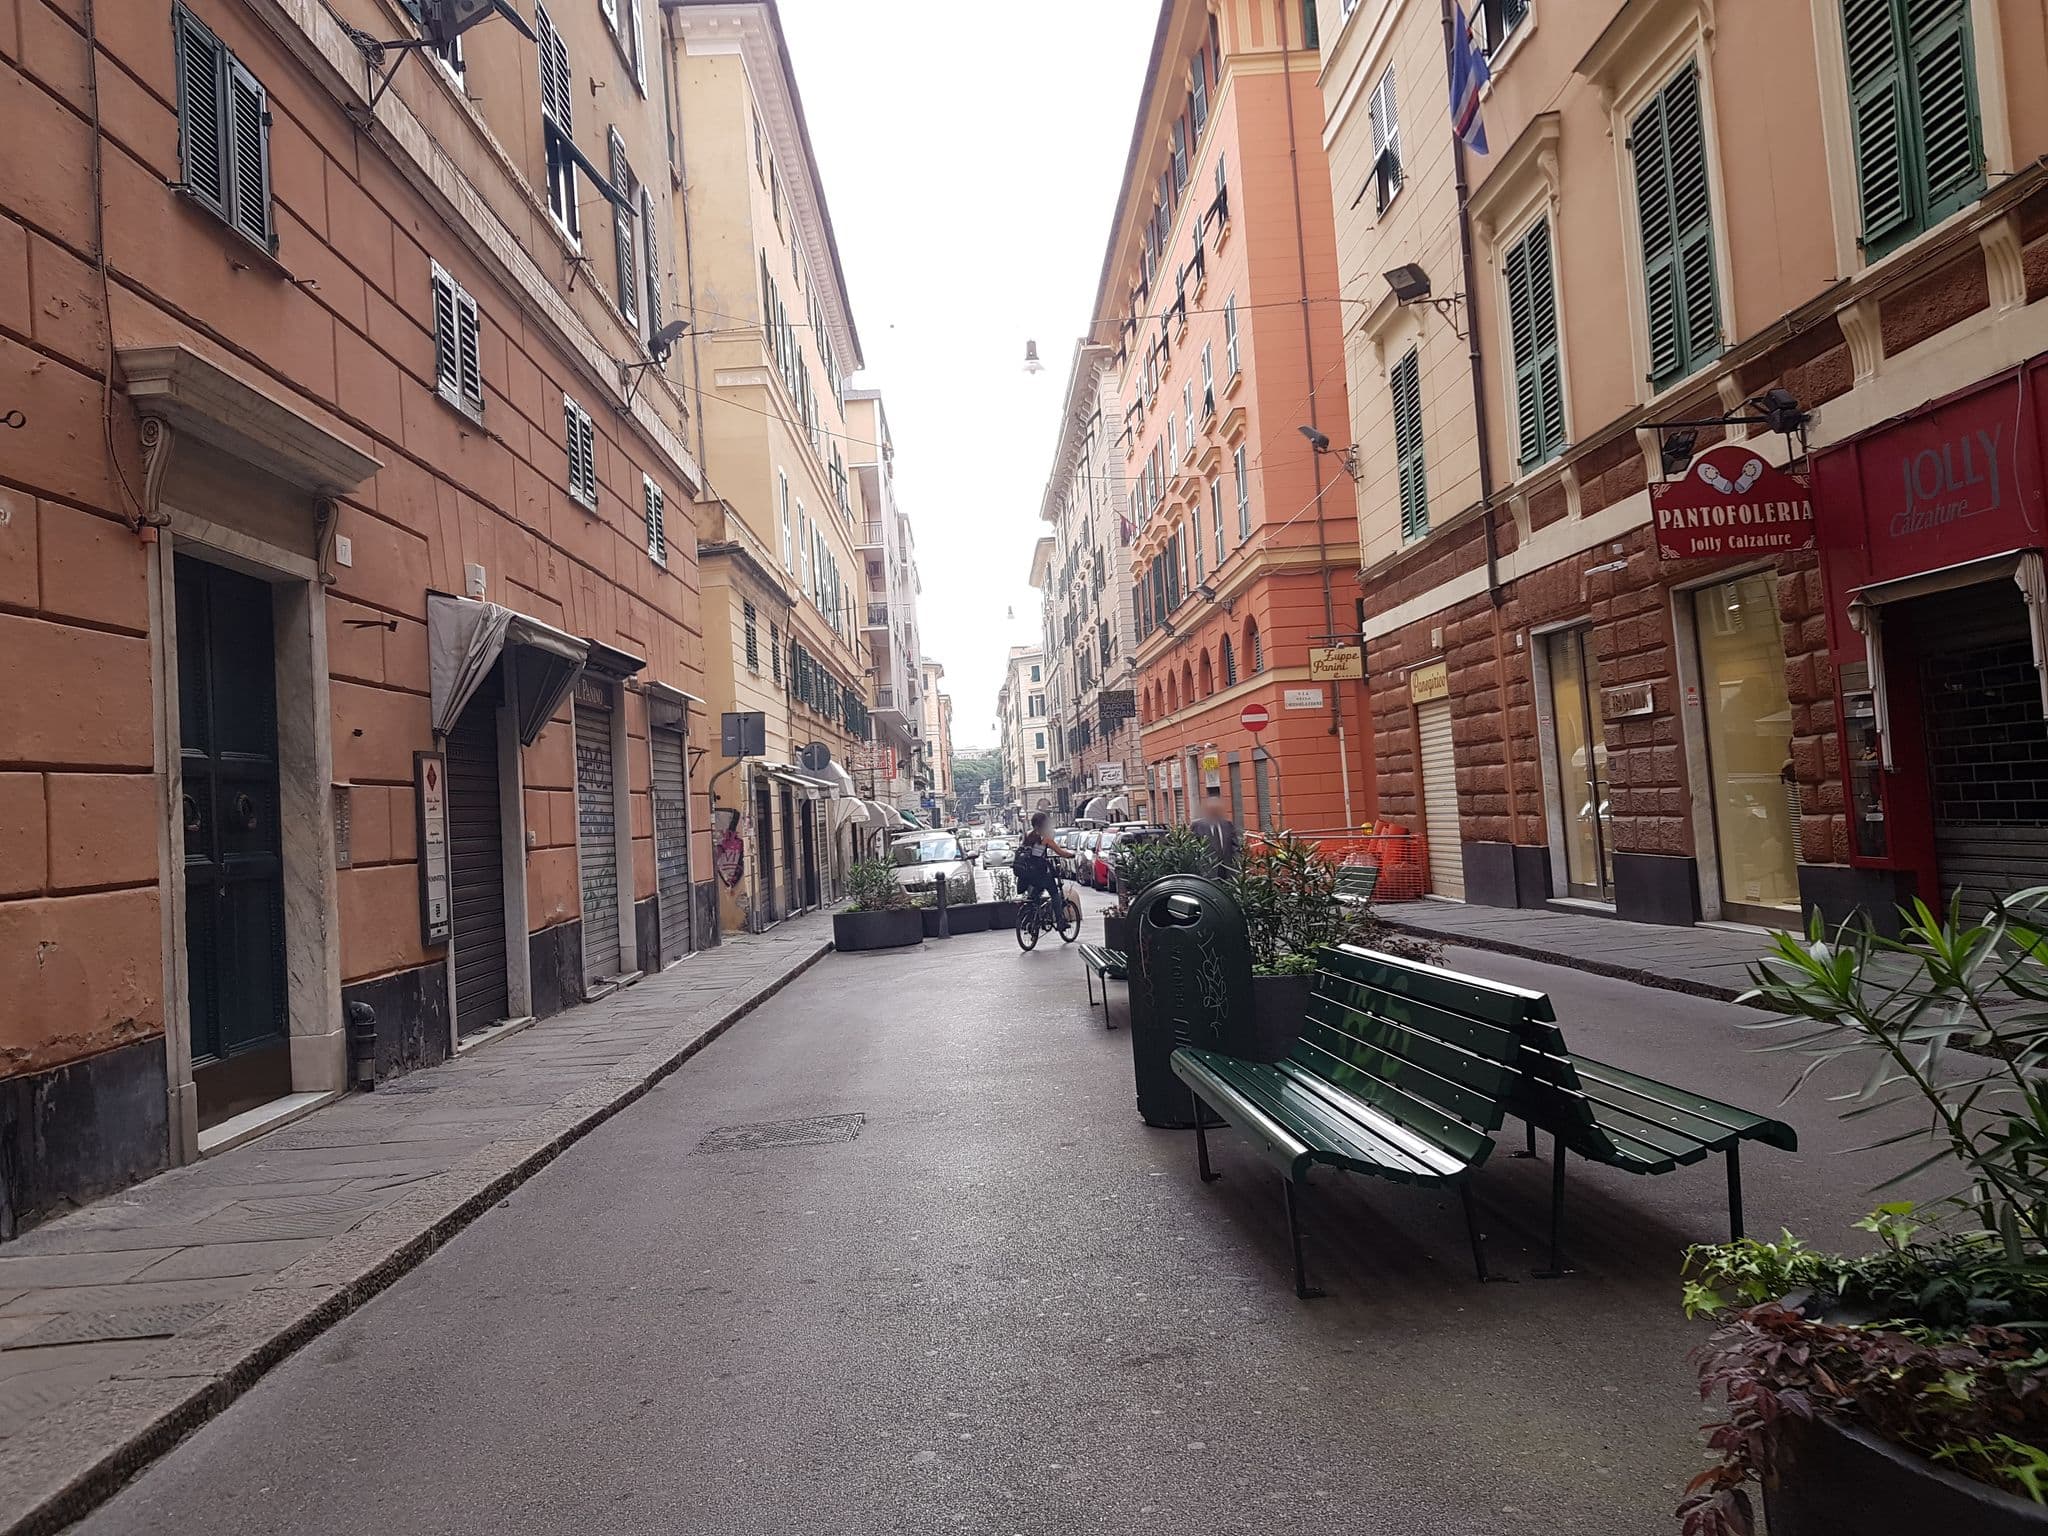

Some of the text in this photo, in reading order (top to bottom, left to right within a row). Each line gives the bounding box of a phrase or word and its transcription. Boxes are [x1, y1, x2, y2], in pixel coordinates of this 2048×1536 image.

[1901, 422, 2001, 515] JOLLY
[1658, 499, 1814, 530] PANTOFOLERIA
[1889, 498, 1969, 537] Calzature
[1690, 532, 1792, 553] Jolly Calzature
[1312, 660, 1349, 674] Panini
[1324, 648, 1360, 662] Zuppe
